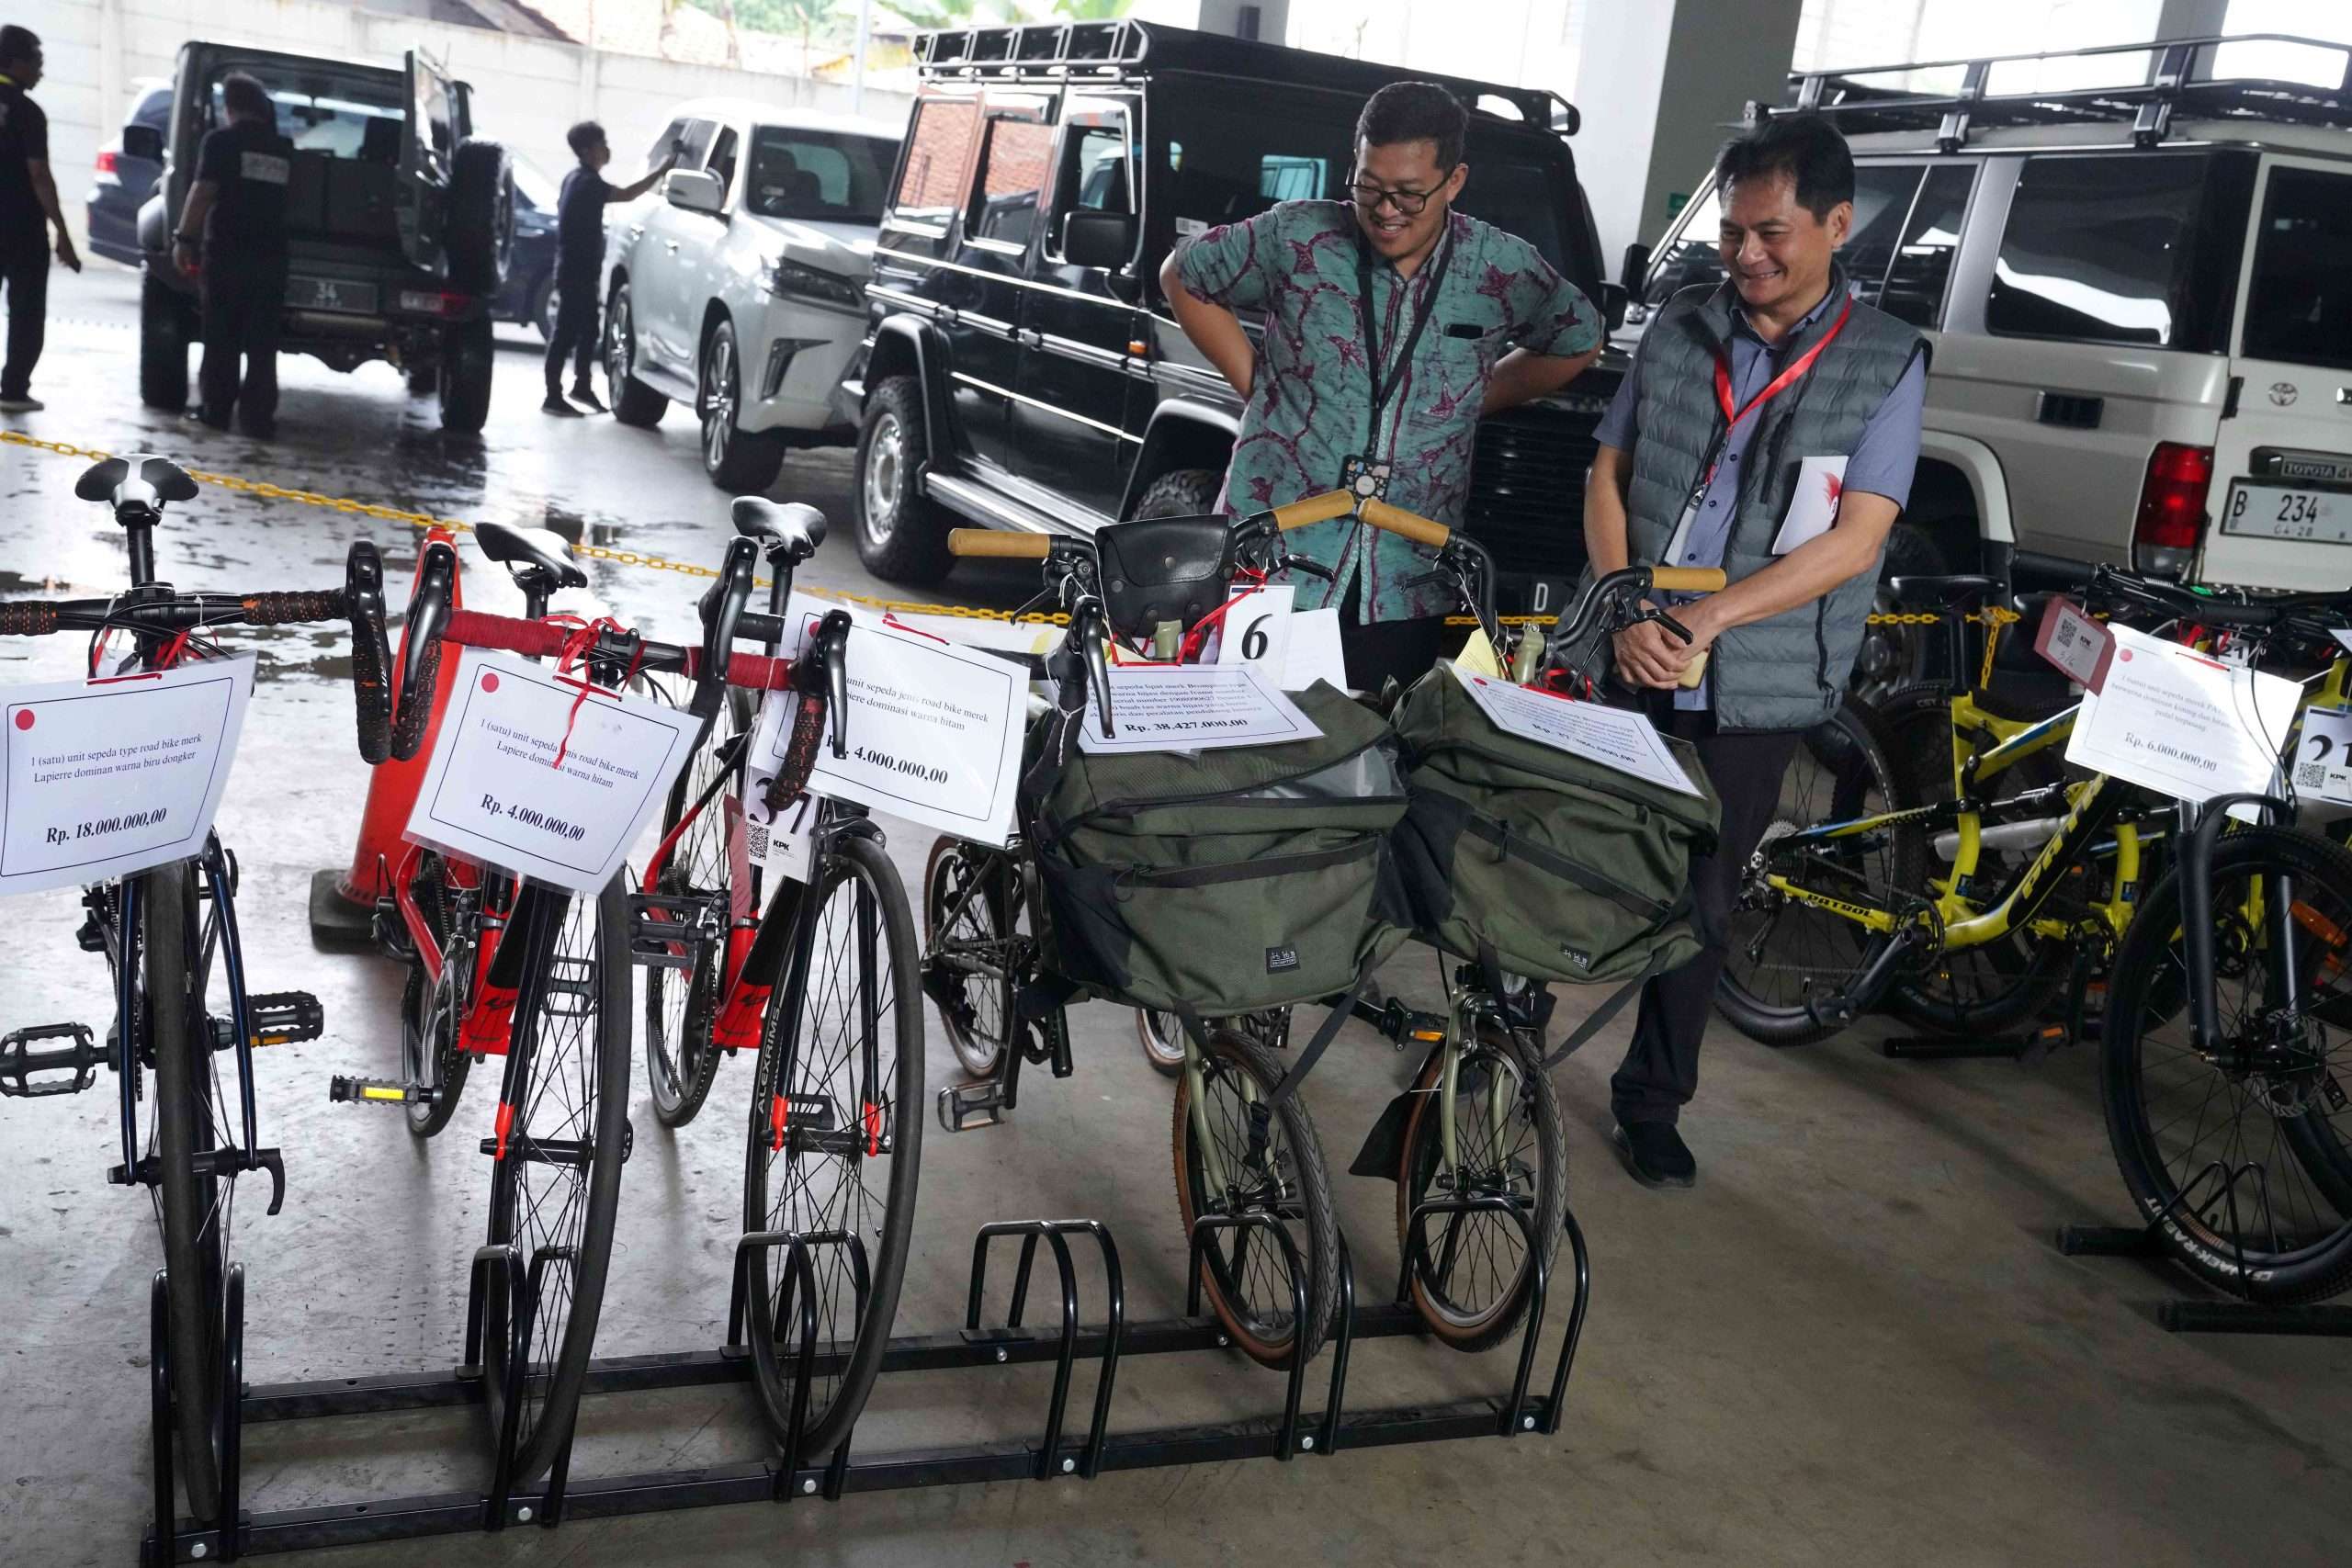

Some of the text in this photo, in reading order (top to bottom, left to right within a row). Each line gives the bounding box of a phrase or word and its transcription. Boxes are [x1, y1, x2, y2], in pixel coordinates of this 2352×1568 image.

[2288, 464, 2333, 476] TOYOTA
[2233, 491, 2317, 524] B 234
[1533, 582, 1549, 613] D
[1241, 613, 1273, 660] 6
[845, 692, 865, 705] iere
[866, 697, 909, 716] dominasi
[940, 716, 965, 730] hitam
[846, 676, 865, 689] unit
[866, 683, 897, 698] sepeda
[921, 696, 942, 709] road
[944, 702, 963, 716] bike
[964, 710, 989, 723] merek
[1125, 724, 1150, 732] Rp.
[34, 750, 198, 784] Lapierre dominan warna biru dongker
[39, 753, 65, 766] (satu)
[67, 751, 85, 763] unit
[87, 747, 117, 761] sepeda
[119, 745, 138, 760] type
[140, 740, 160, 754] road
[162, 738, 179, 750] bike
[181, 733, 203, 746] merk
[480, 718, 486, 728] 1
[487, 720, 512, 737] (satu)
[512, 730, 530, 743] unit
[531, 737, 558, 753] sepeda
[579, 751, 598, 766] road
[598, 757, 616, 773] bike
[615, 765, 640, 780] merek
[496, 740, 615, 789] Lapiere dominsi warna hitam
[854, 746, 948, 784] 4.000.000,00
[2125, 731, 2218, 772] Rp. 6.000.000,00
[2329, 772, 2347, 781] KPK
[46, 807, 167, 845] Rp. 18.000.000,00
[481, 793, 585, 841] Rp. 4.000.000,00
[2023, 773, 2109, 899] PATR
[773, 839, 790, 852] KPK
[1807, 894, 1872, 917] PATROL
[758, 1006, 780, 1114] ALEXRIMS
[2144, 1197, 2199, 1253] RABIT
